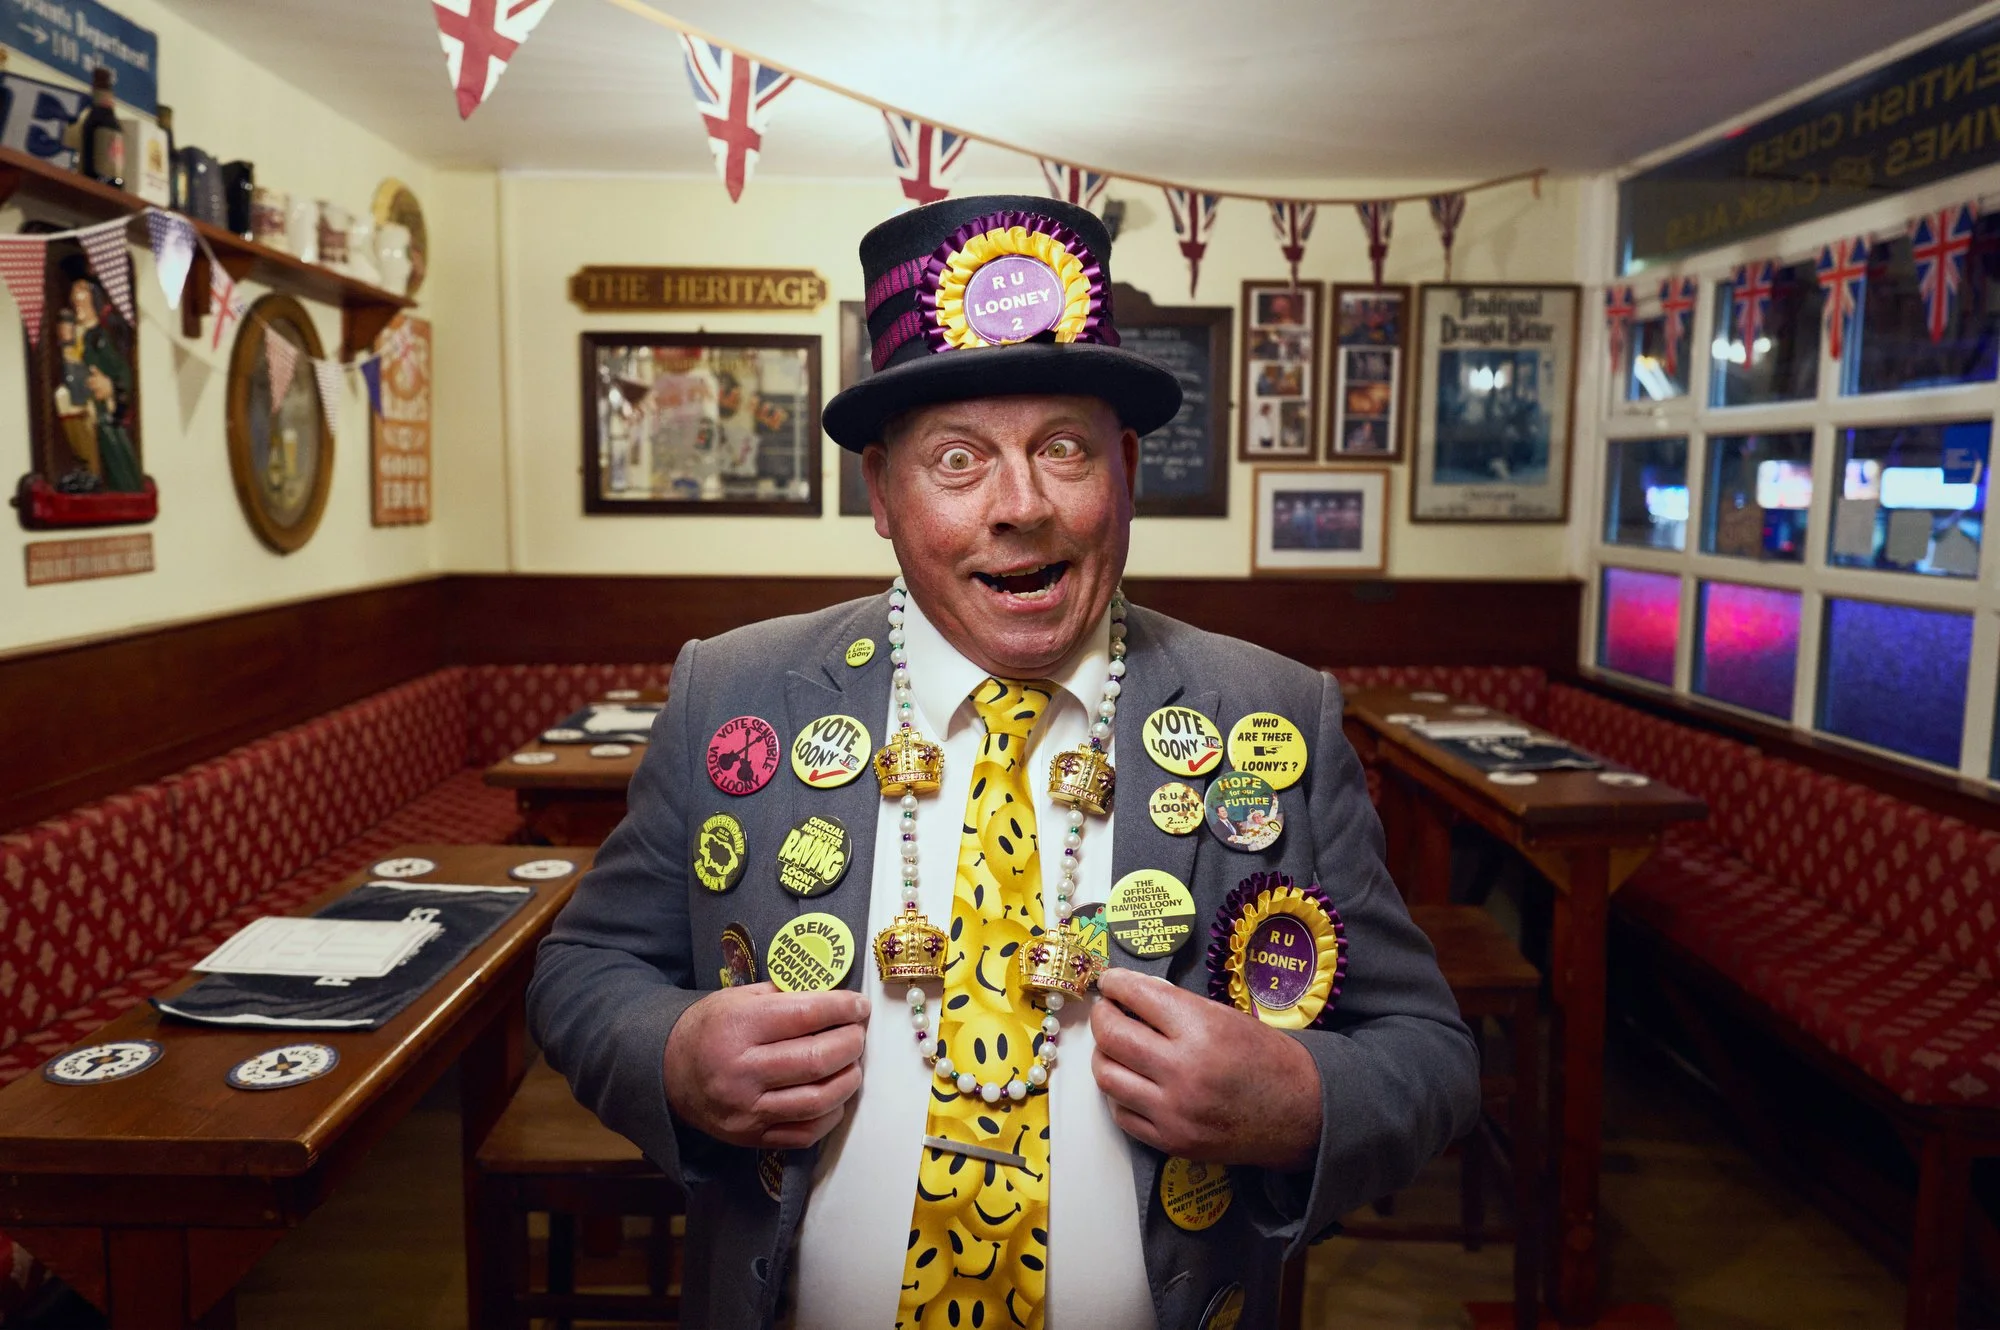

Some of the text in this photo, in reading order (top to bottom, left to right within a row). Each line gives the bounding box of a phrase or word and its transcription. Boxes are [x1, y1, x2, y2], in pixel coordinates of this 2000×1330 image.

[587, 274, 820, 306] THE HERITAGE
[992, 271, 1024, 290] R U
[974, 288, 1051, 317] LOONEY
[1011, 317, 1024, 331] 2
[1151, 709, 1206, 736] VOTE
[1252, 718, 1279, 728] WHO
[811, 717, 861, 754] VOTE
[1237, 732, 1293, 742] ARE THESE
[717, 718, 778, 773] VOTE SENSIBLE
[795, 738, 840, 768] LOONY
[1151, 738, 1198, 760] LOONY
[708, 746, 760, 793] VOTE LOONY
[1241, 761, 1298, 772] LOONY'S ?
[1218, 776, 1262, 791] HOPE
[1152, 802, 1200, 814] LOONY
[1224, 797, 1270, 808] FUTURE
[802, 823, 843, 848] MONSTER
[809, 816, 844, 839] OFFICIAL
[778, 828, 845, 882] RAVING
[694, 858, 727, 891] LOONY
[780, 873, 812, 895] PARTY
[782, 864, 819, 887] LOONY
[1134, 880, 1154, 888] THE
[1122, 892, 1170, 904] MONSTER
[1124, 886, 1168, 896] OFFICIAL
[1111, 898, 1183, 912] RAVING LOONY
[1132, 908, 1164, 918] PARTY
[1114, 924, 1190, 940] TEENAGERS
[1138, 918, 1164, 928] FOR
[794, 922, 846, 970] BEWARE
[1131, 934, 1176, 946] OF ALL
[1270, 930, 1294, 946] R U
[1138, 943, 1171, 954] AGES
[774, 946, 820, 990] RAVING
[778, 933, 834, 986] MONSTER
[1249, 949, 1308, 972] LOONEY
[1270, 976, 1279, 990] 2
[760, 1159, 781, 1192] LOON
[1172, 1200, 1192, 1214] PARTY
